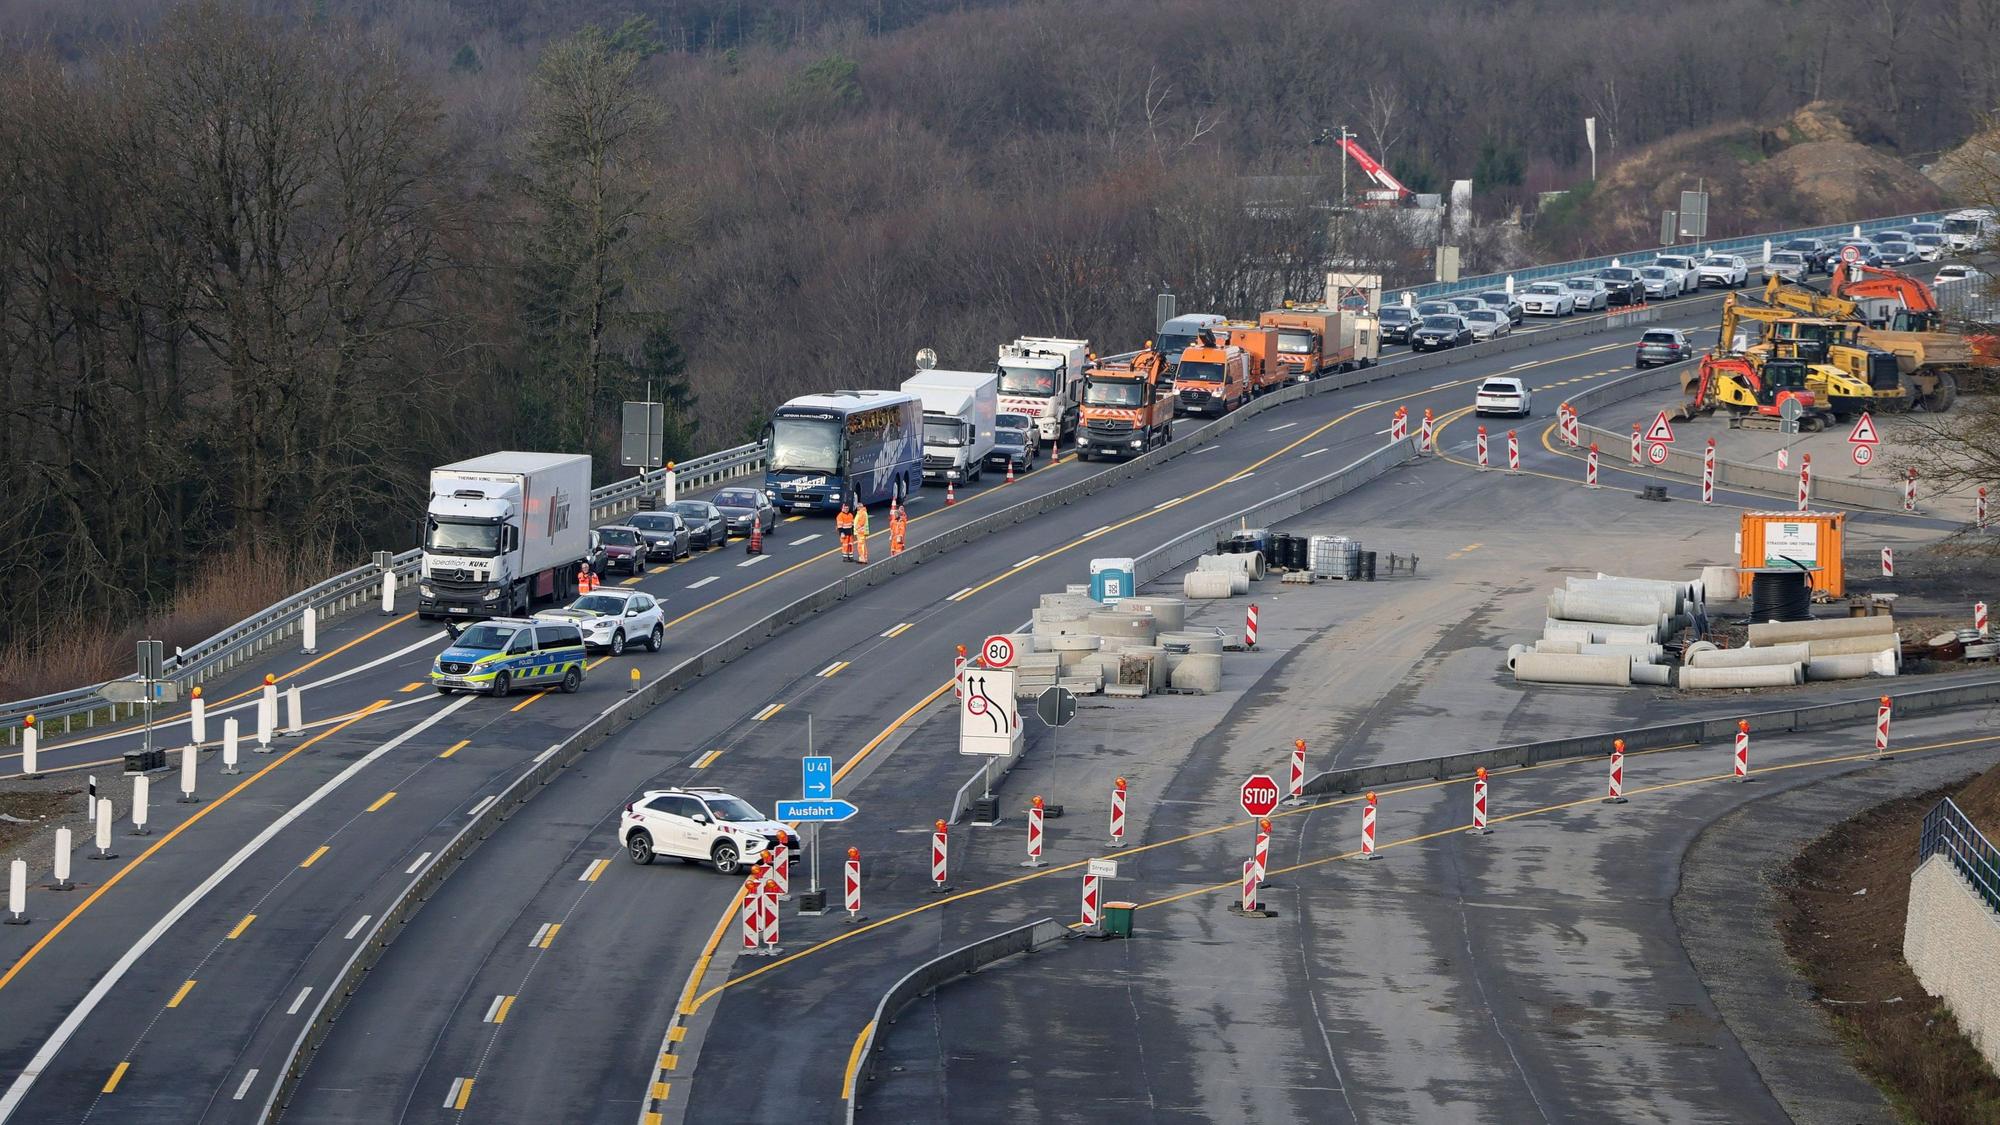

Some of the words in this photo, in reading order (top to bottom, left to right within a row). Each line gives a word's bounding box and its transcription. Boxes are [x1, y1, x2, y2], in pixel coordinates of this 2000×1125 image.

[1652, 447, 1664, 459] 40
[1856, 449, 1869, 461] 40
[431, 558, 466, 568] Spedition
[468, 560, 489, 568] KUNZ
[989, 644, 1008, 660] 80
[807, 762, 815, 772] U
[817, 762, 827, 772] 41
[1244, 787, 1275, 805] STOP
[788, 806, 834, 816] Ausfahrt
